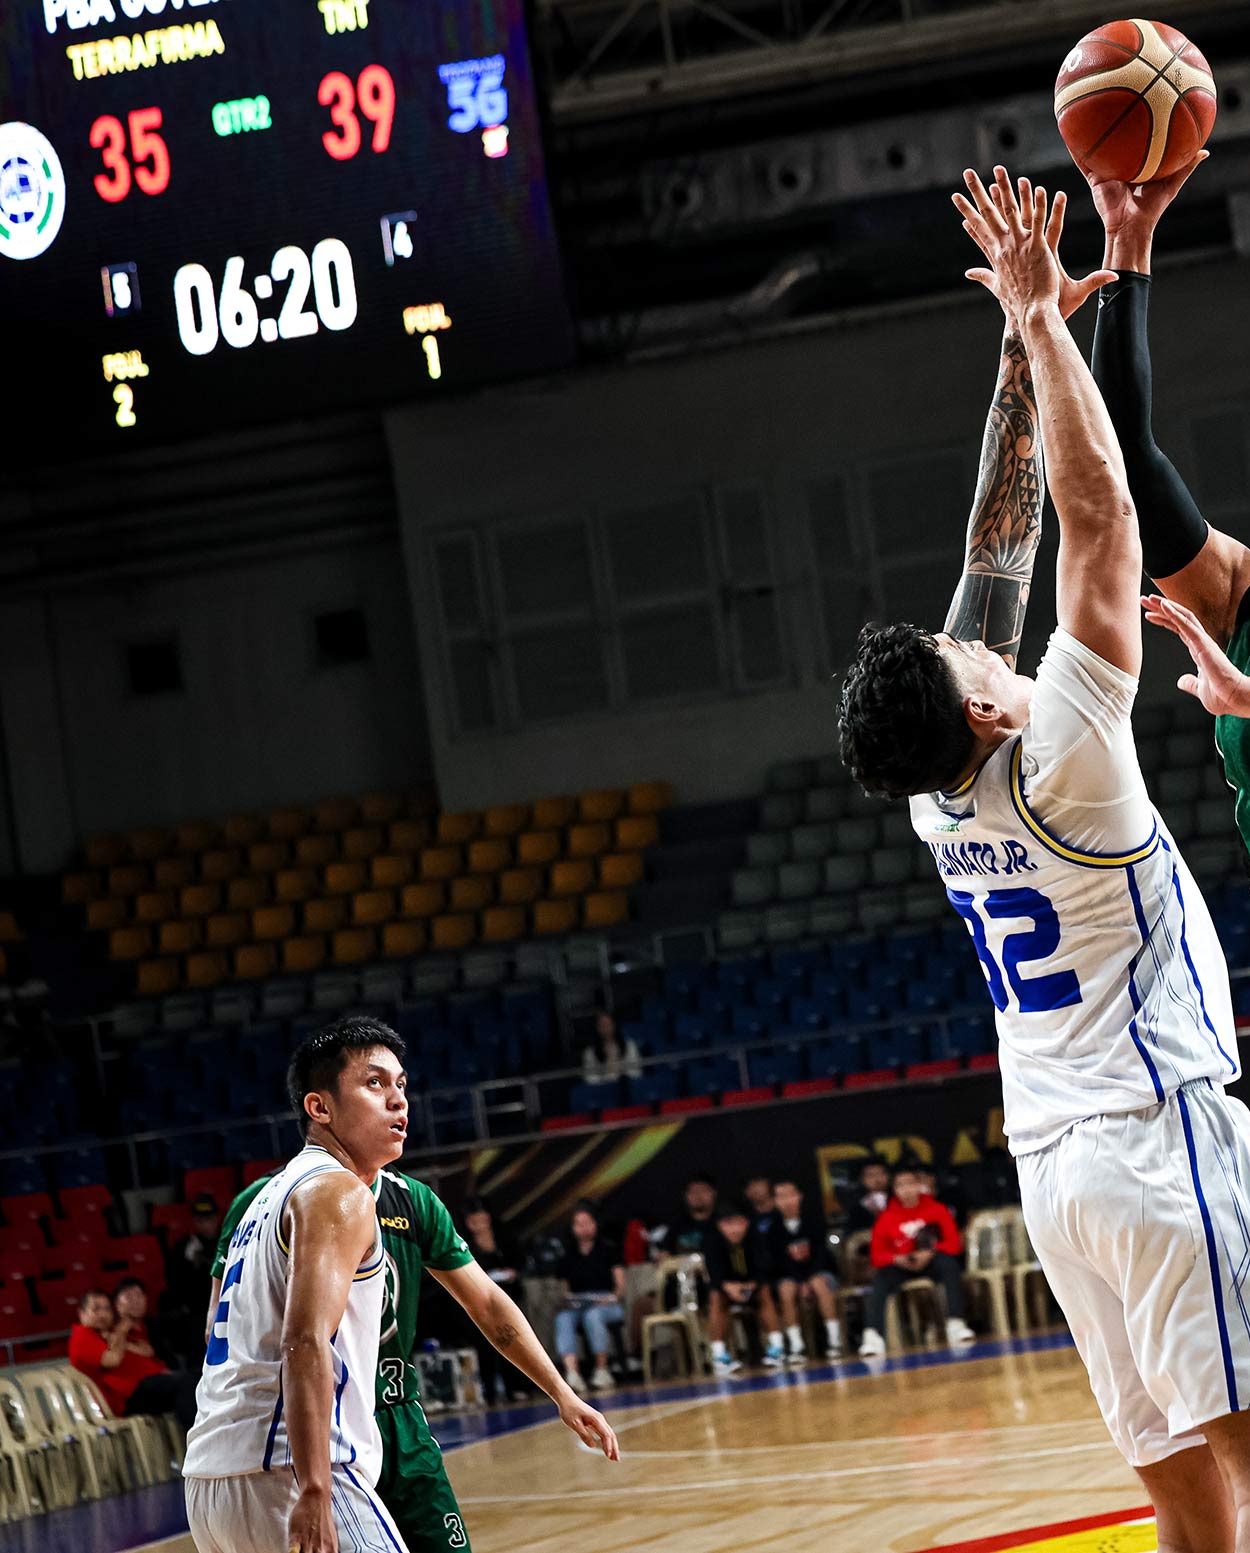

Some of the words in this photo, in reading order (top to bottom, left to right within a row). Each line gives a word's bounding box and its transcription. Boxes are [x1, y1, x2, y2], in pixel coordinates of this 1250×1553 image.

[66, 19, 225, 81] TERRAFIRMA
[317, 63, 396, 161] 39
[89, 105, 171, 203] 35
[173, 238, 358, 355] 06:20
[422, 334, 441, 379] 1
[113, 383, 136, 427] 2
[1000, 840, 1039, 875] JR.
[379, 1357, 405, 1404] 3
[443, 1512, 468, 1549] 3
